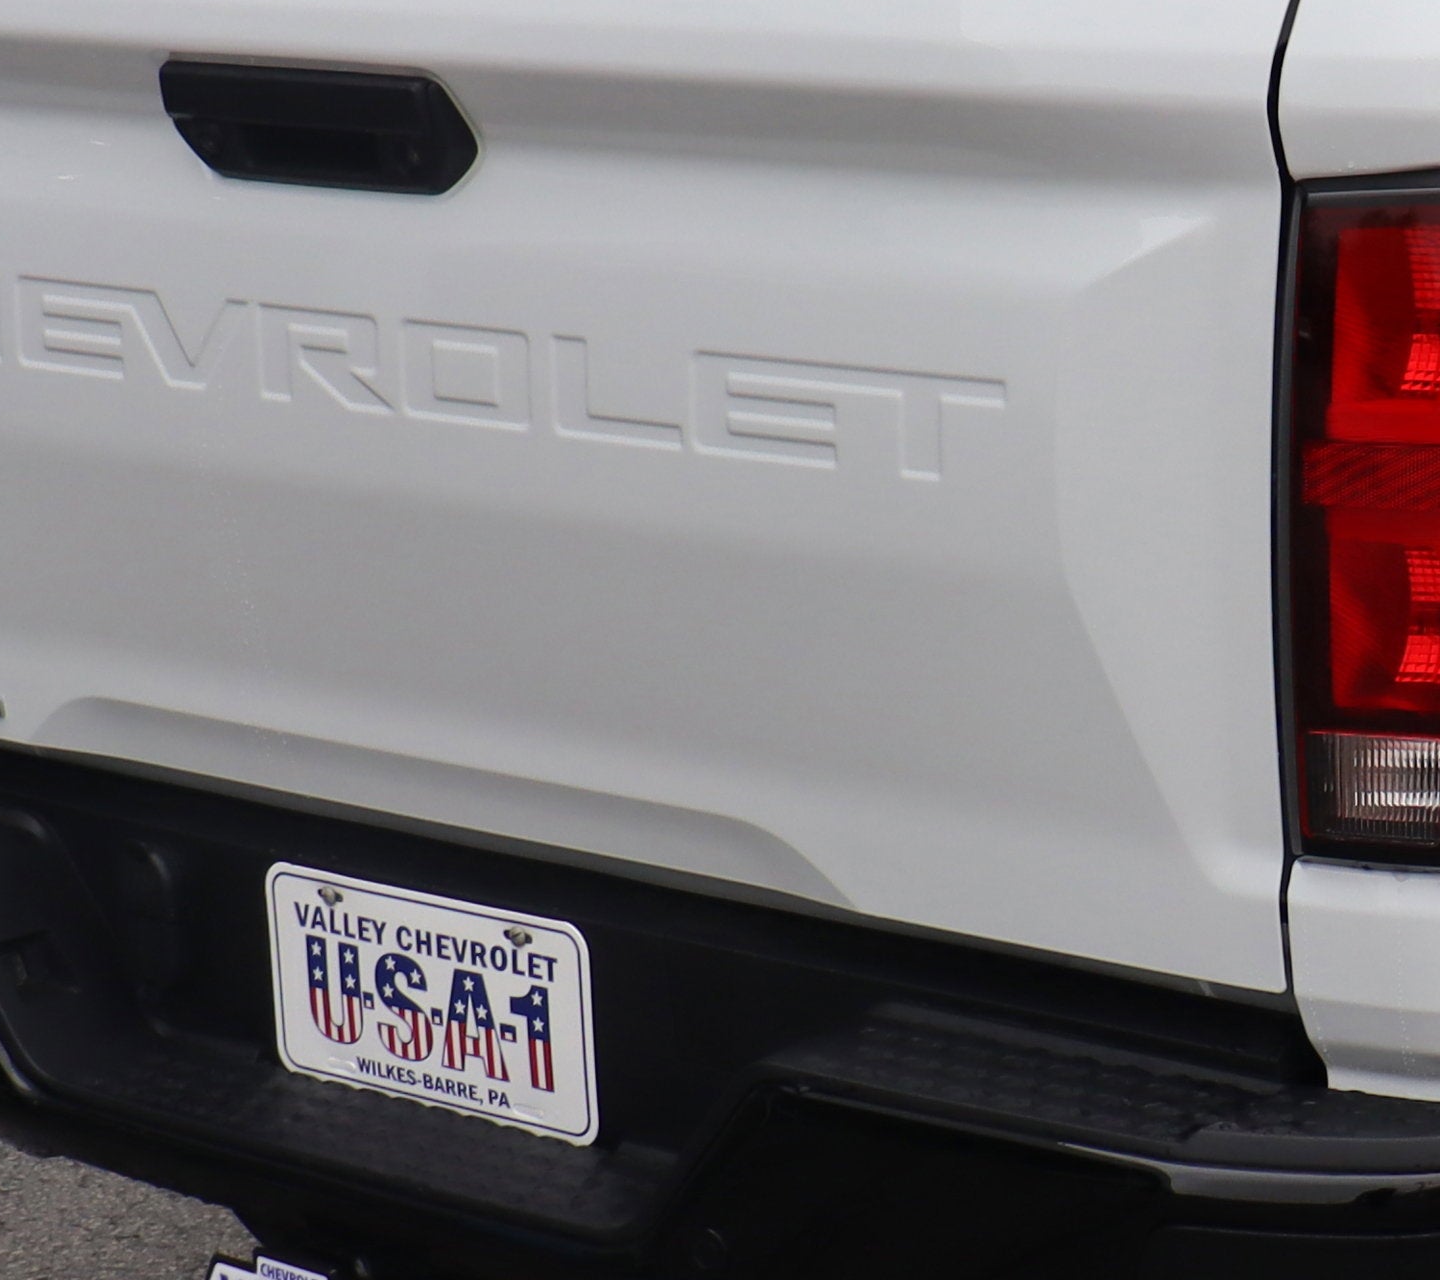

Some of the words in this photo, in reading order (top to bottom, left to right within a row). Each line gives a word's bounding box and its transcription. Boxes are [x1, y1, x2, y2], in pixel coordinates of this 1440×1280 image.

[294, 901, 387, 945] VALLEY
[395, 925, 558, 983] CHEVROLET
[356, 1056, 484, 1106] WILKES-BARRE,
[488, 1088, 511, 1109] PA
